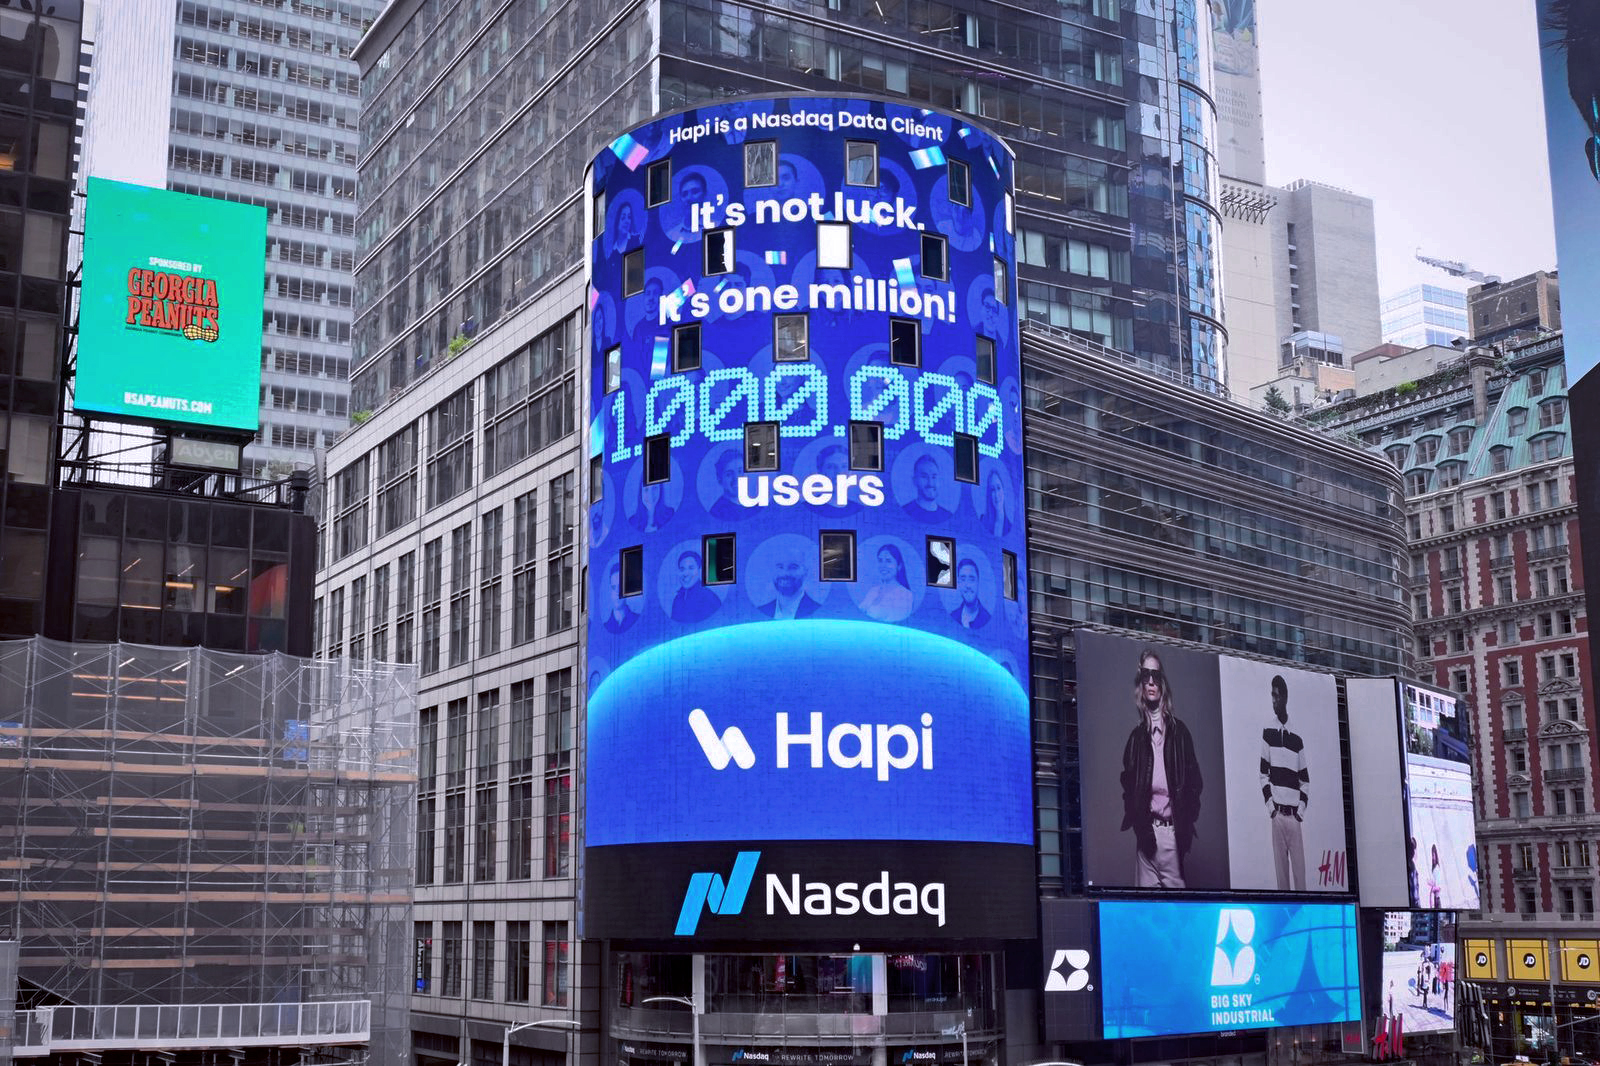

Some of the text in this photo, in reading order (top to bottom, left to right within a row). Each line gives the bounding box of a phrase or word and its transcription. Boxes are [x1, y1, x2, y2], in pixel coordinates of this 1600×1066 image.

[669, 110, 943, 144] Hapi is a Nasdaq Data Client
[755, 192, 824, 225] not
[834, 191, 925, 231] luck.
[149, 256, 203, 273] SPONSORED BY
[127, 267, 219, 308] GEORGIA
[718, 283, 799, 314] one
[809, 275, 956, 323] million!
[125, 296, 219, 332] PEANUTS
[124, 391, 213, 414] USAPEANUTS.COM
[737, 473, 885, 508] users
[776, 711, 934, 781] Hapi
[1318, 850, 1346, 888] H&M
[765, 871, 946, 928] Nasdaq
[1477, 955, 1487, 964] JD
[1525, 956, 1535, 965] JD
[1579, 957, 1590, 966] JD
[1211, 993, 1253, 1009] BIG SKY
[1211, 1009, 1275, 1026] INDUSTRIAL
[743, 1052, 769, 1061] Nasdaq
[913, 1051, 936, 1060] Nasdaq
